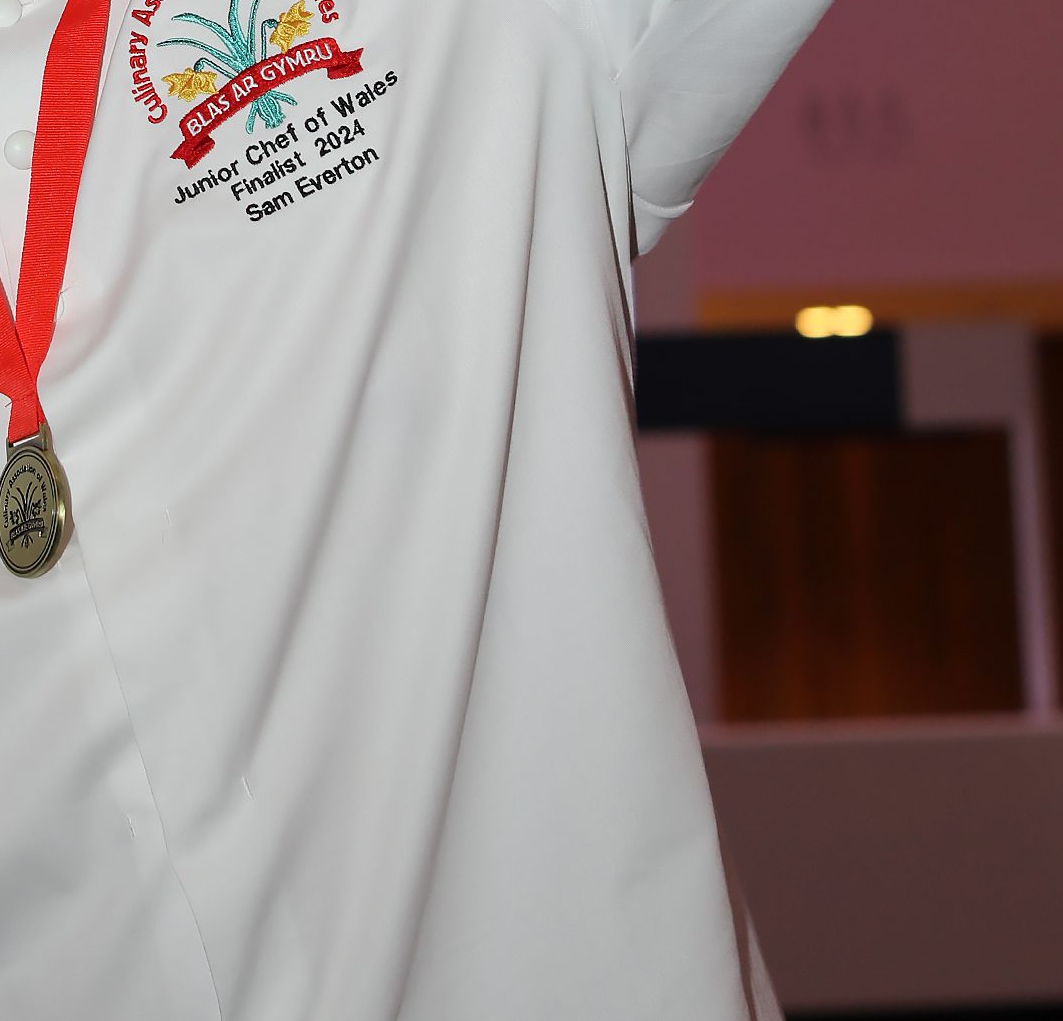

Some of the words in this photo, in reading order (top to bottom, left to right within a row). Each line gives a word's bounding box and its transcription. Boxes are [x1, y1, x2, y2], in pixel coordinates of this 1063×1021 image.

[129, 31, 168, 124] Culinary
[186, 94, 230, 137] BLAS
[231, 75, 259, 103] AR
[259, 42, 334, 81] GYMRU
[174, 159, 239, 204] Junior
[245, 123, 299, 166] Chef
[304, 107, 327, 133] of
[330, 70, 398, 118] Wales
[231, 151, 306, 202] Finalist
[314, 119, 366, 158] 2024
[246, 192, 295, 222] Sam
[294, 147, 380, 198] Everton
